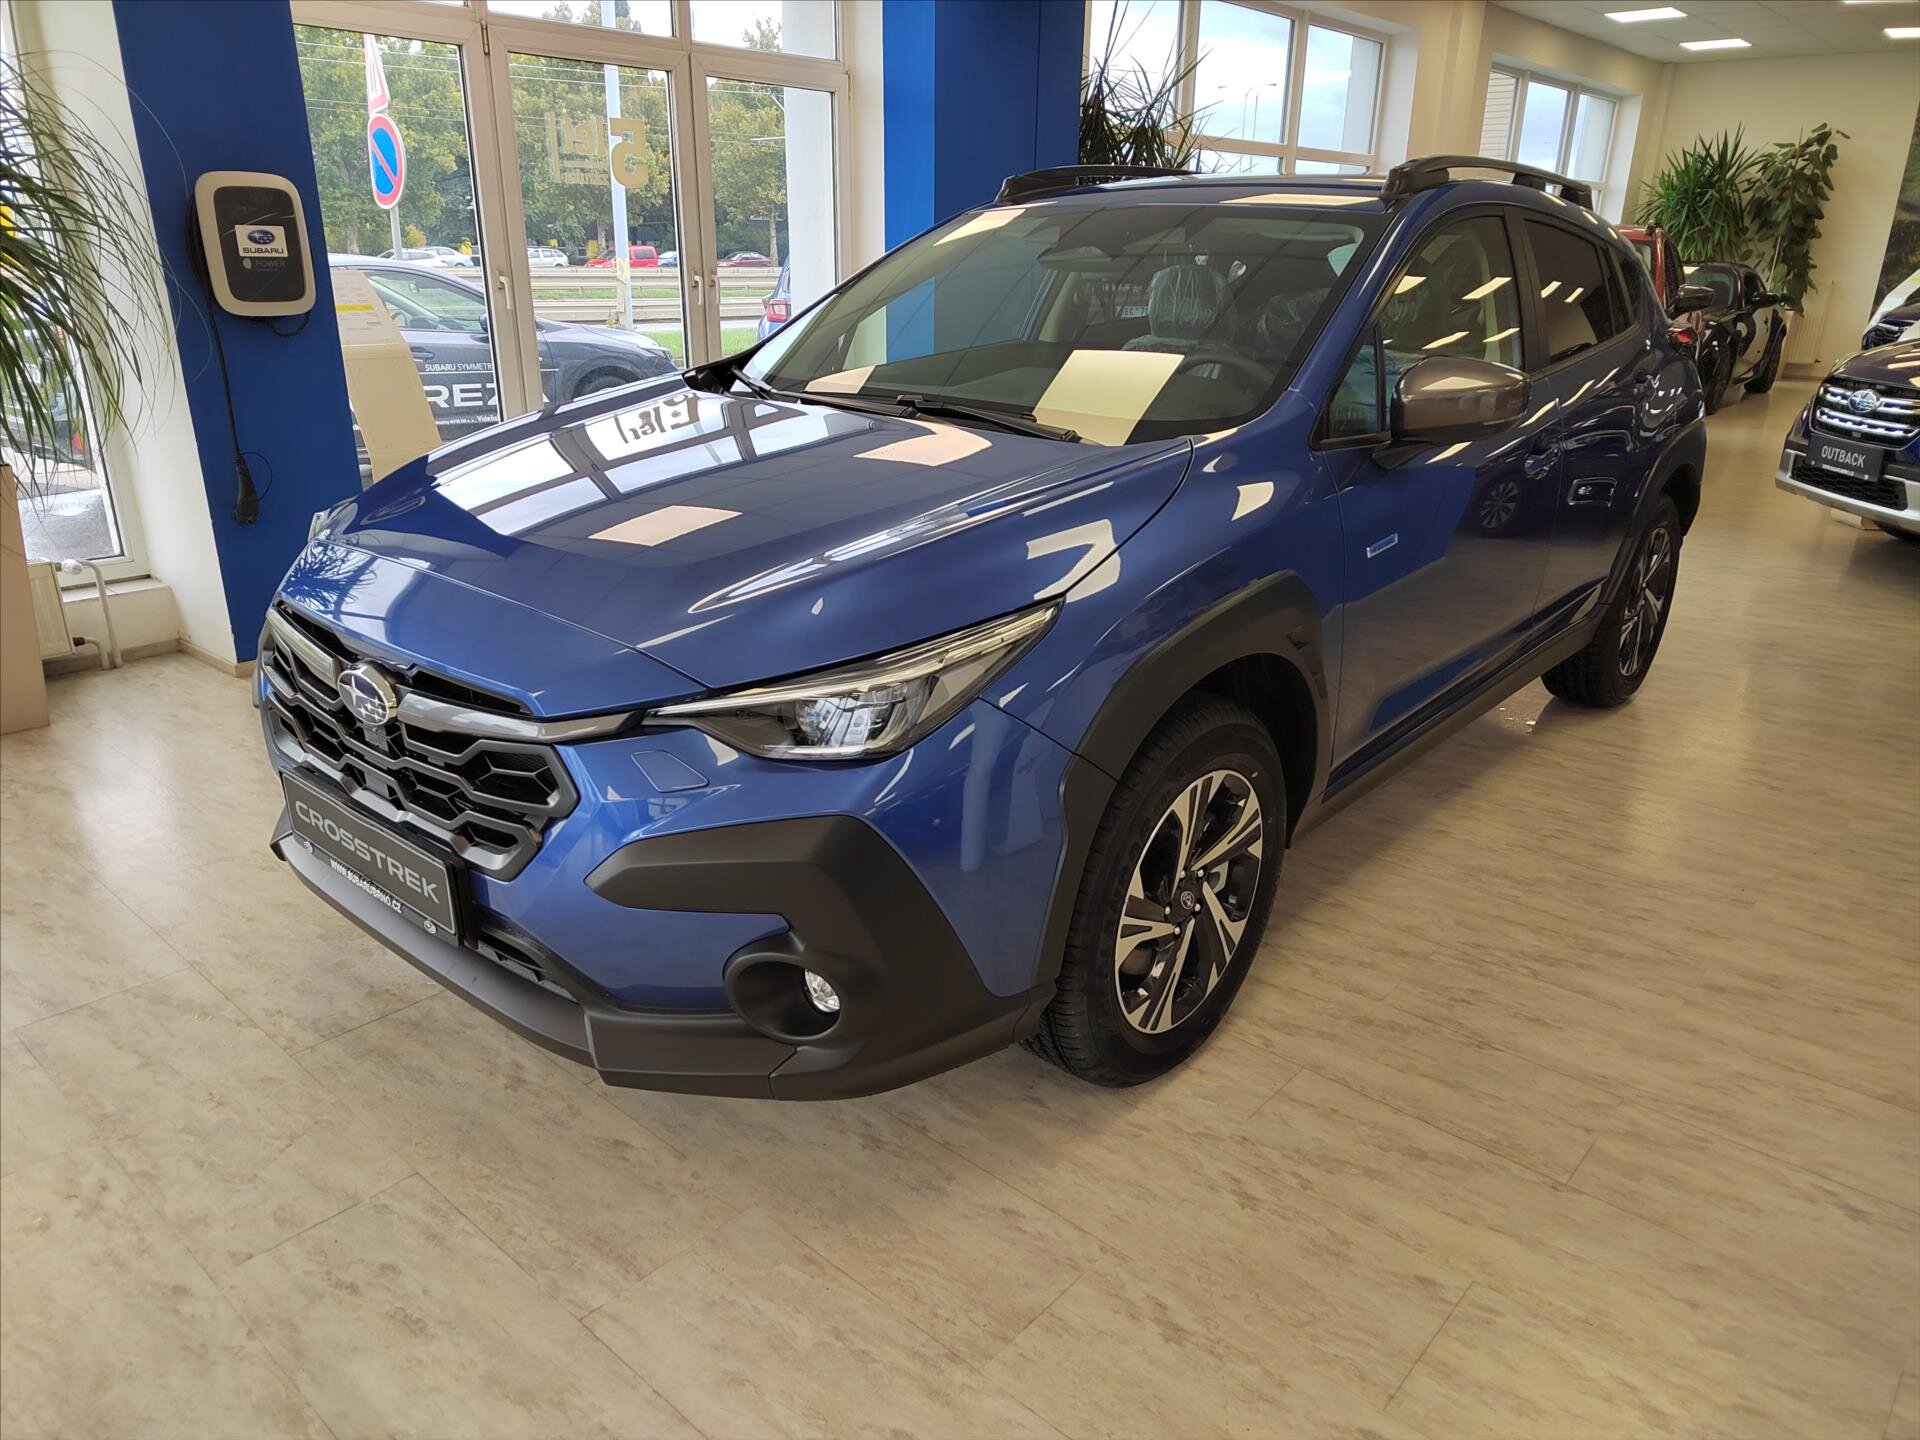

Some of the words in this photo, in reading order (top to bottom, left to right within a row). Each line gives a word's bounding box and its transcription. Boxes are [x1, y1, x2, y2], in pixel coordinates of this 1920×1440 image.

[425, 363, 456, 372] SUBARU
[458, 362, 493, 371] SYMMETR
[1821, 445, 1866, 468] OUTBACK
[294, 800, 440, 904] CROSSTREK
